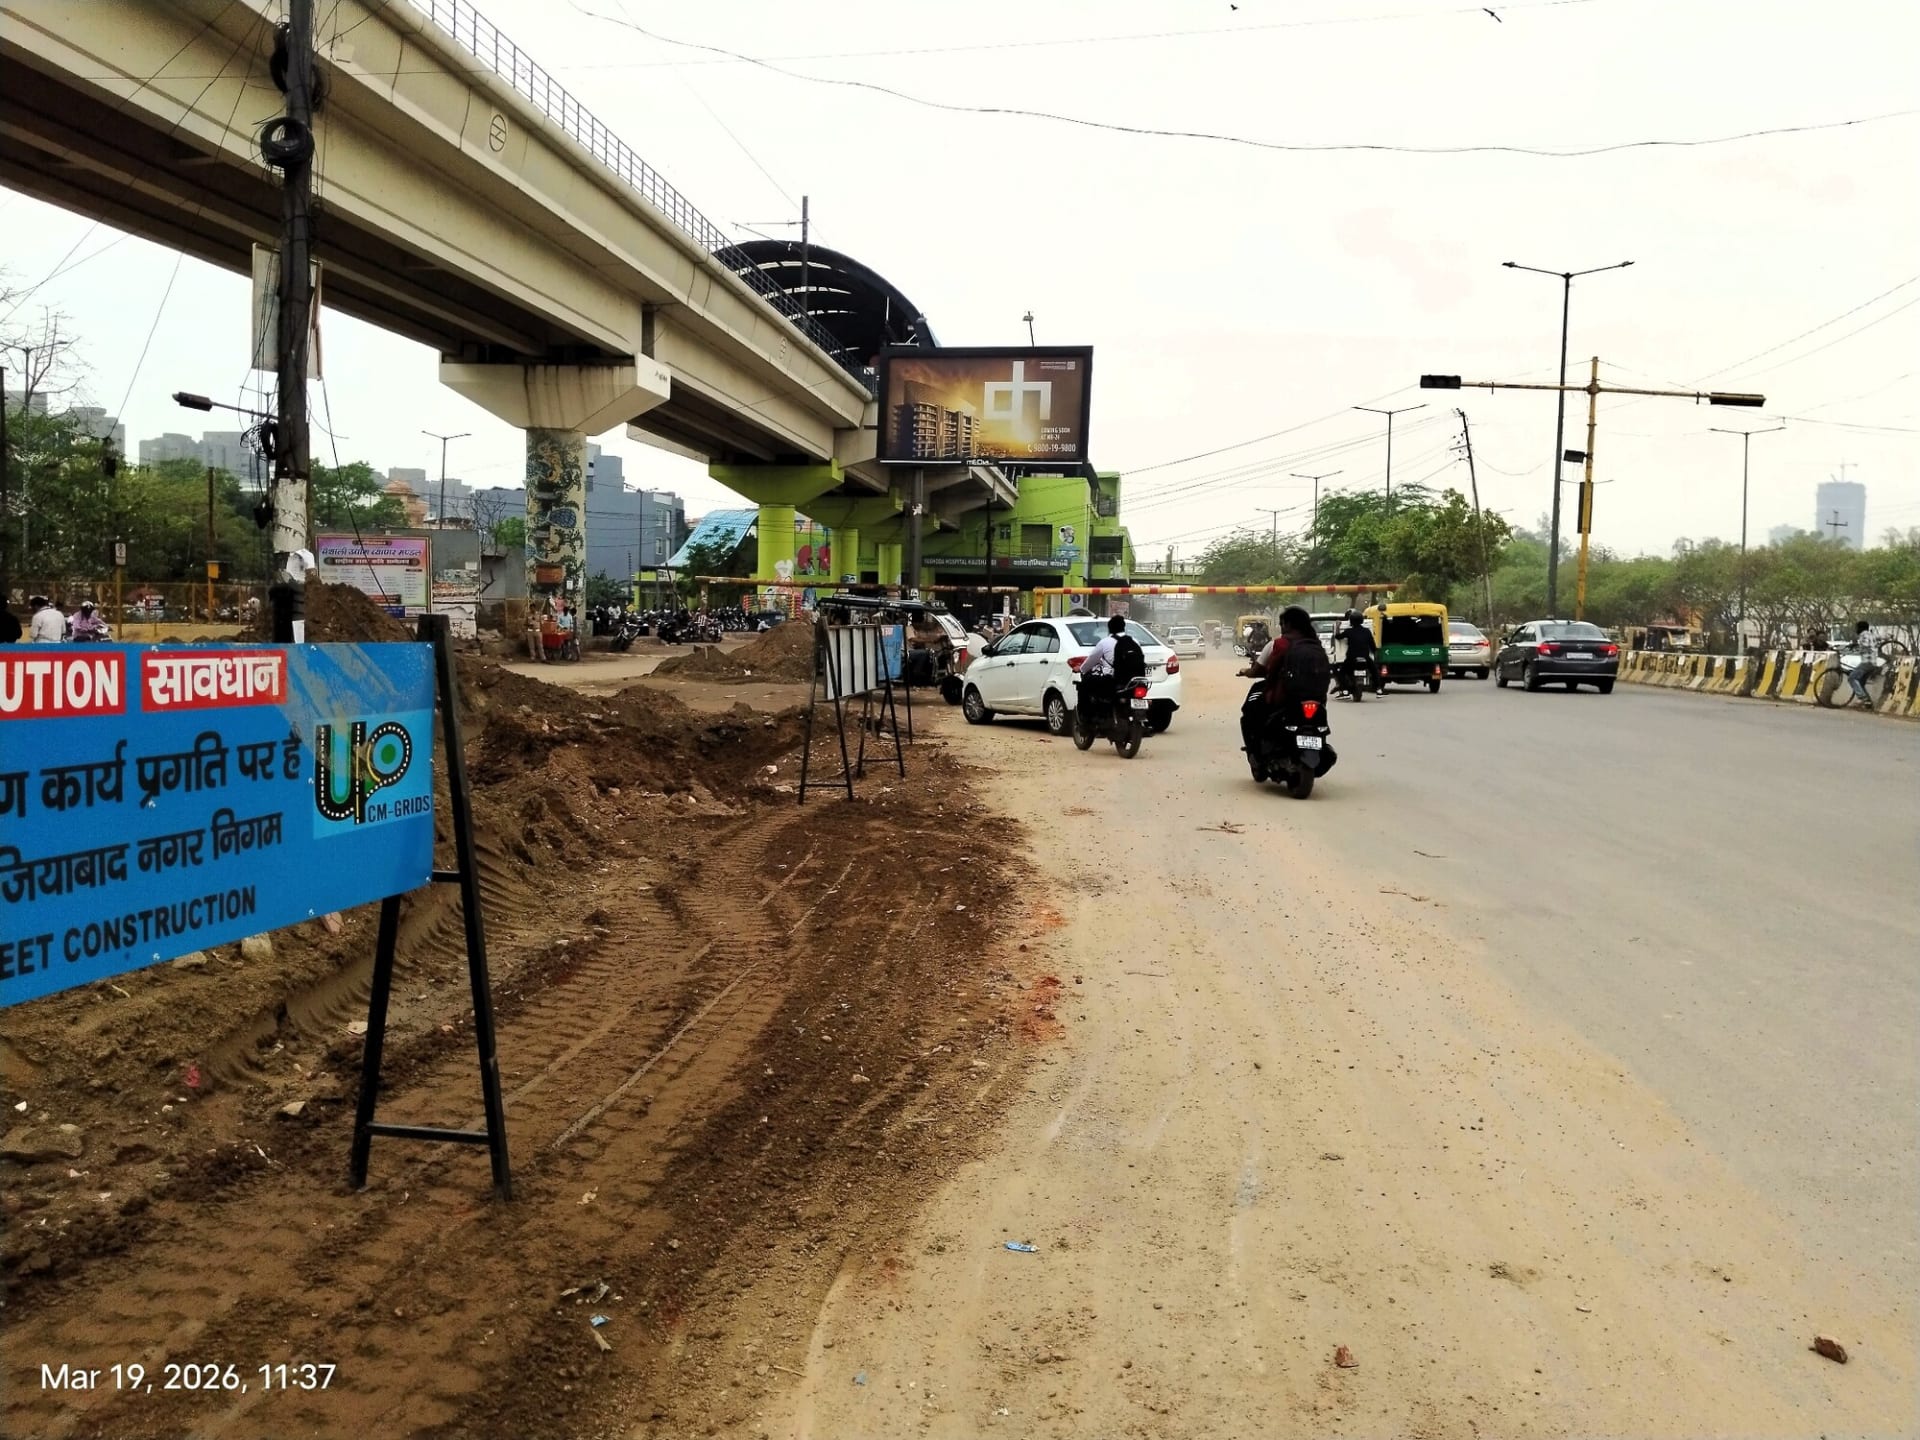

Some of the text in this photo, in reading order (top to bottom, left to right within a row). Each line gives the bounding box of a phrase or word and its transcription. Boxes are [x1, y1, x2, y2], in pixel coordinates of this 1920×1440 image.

[0, 660, 119, 712] UTION
[147, 656, 282, 705] सावधान
[40, 739, 127, 811] कार्य
[136, 731, 229, 809] प्रगति
[236, 741, 276, 781] पर
[368, 796, 430, 822] CM-GRIDS
[137, 829, 205, 873] नगर
[211, 808, 282, 860] निगम
[63, 885, 256, 963] CONSTRUCTION
